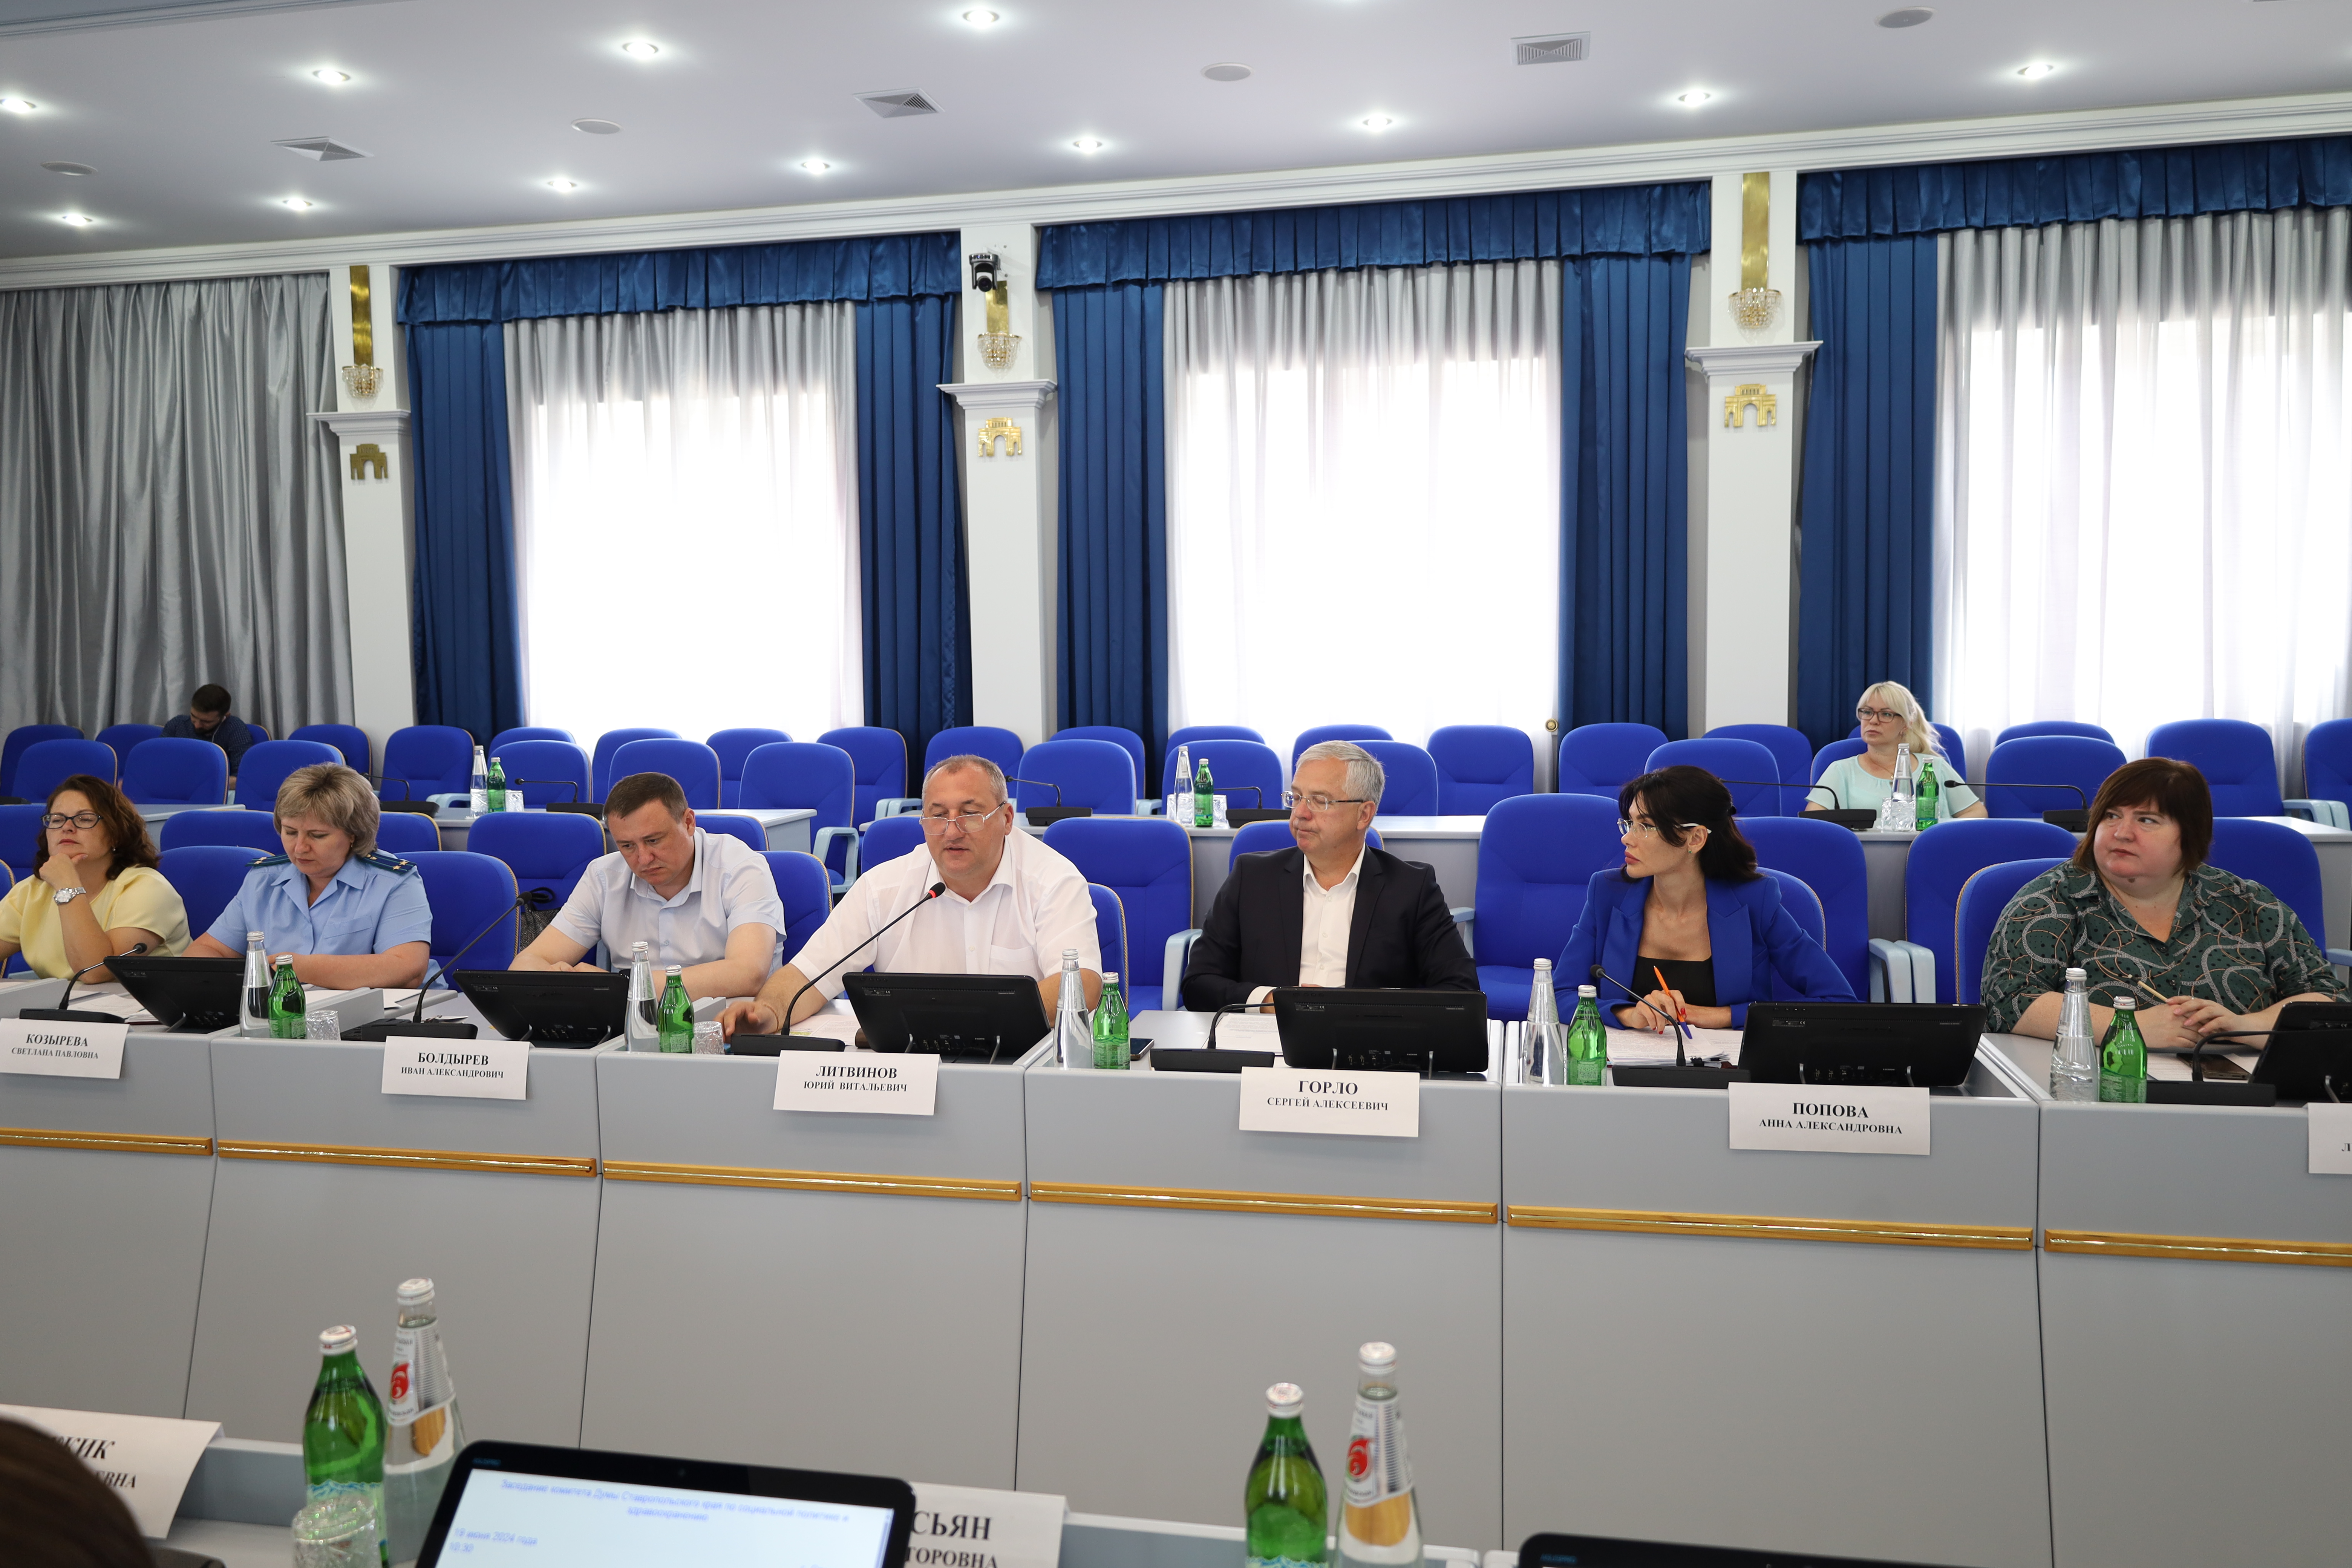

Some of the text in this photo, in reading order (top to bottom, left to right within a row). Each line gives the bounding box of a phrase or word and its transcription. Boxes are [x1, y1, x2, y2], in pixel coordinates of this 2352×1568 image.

[26, 1034, 88, 1047] КОЗЫРЕВА
[11, 1047, 98, 1059] СВЕТЛАНА ПАВЛОВНА
[418, 1052, 489, 1066] БОЛДЫРЕВ
[401, 1067, 504, 1078] ИВАН АЛЕКСАНДРОВИЧ
[815, 1066, 897, 1079] ЛИТВИНОВ
[804, 1080, 907, 1092] ЮРИЙ ВИТАЛЬЕВИЧ
[1298, 1080, 1358, 1095] ГОРЛО
[1267, 1096, 1388, 1111] СЕРГЕЙ АЛЕКСЕЕВИЧ
[1793, 1102, 1869, 1118] ПОПОВА
[1759, 1119, 1902, 1134] АННА АЛЕКСАНДРОВНА
